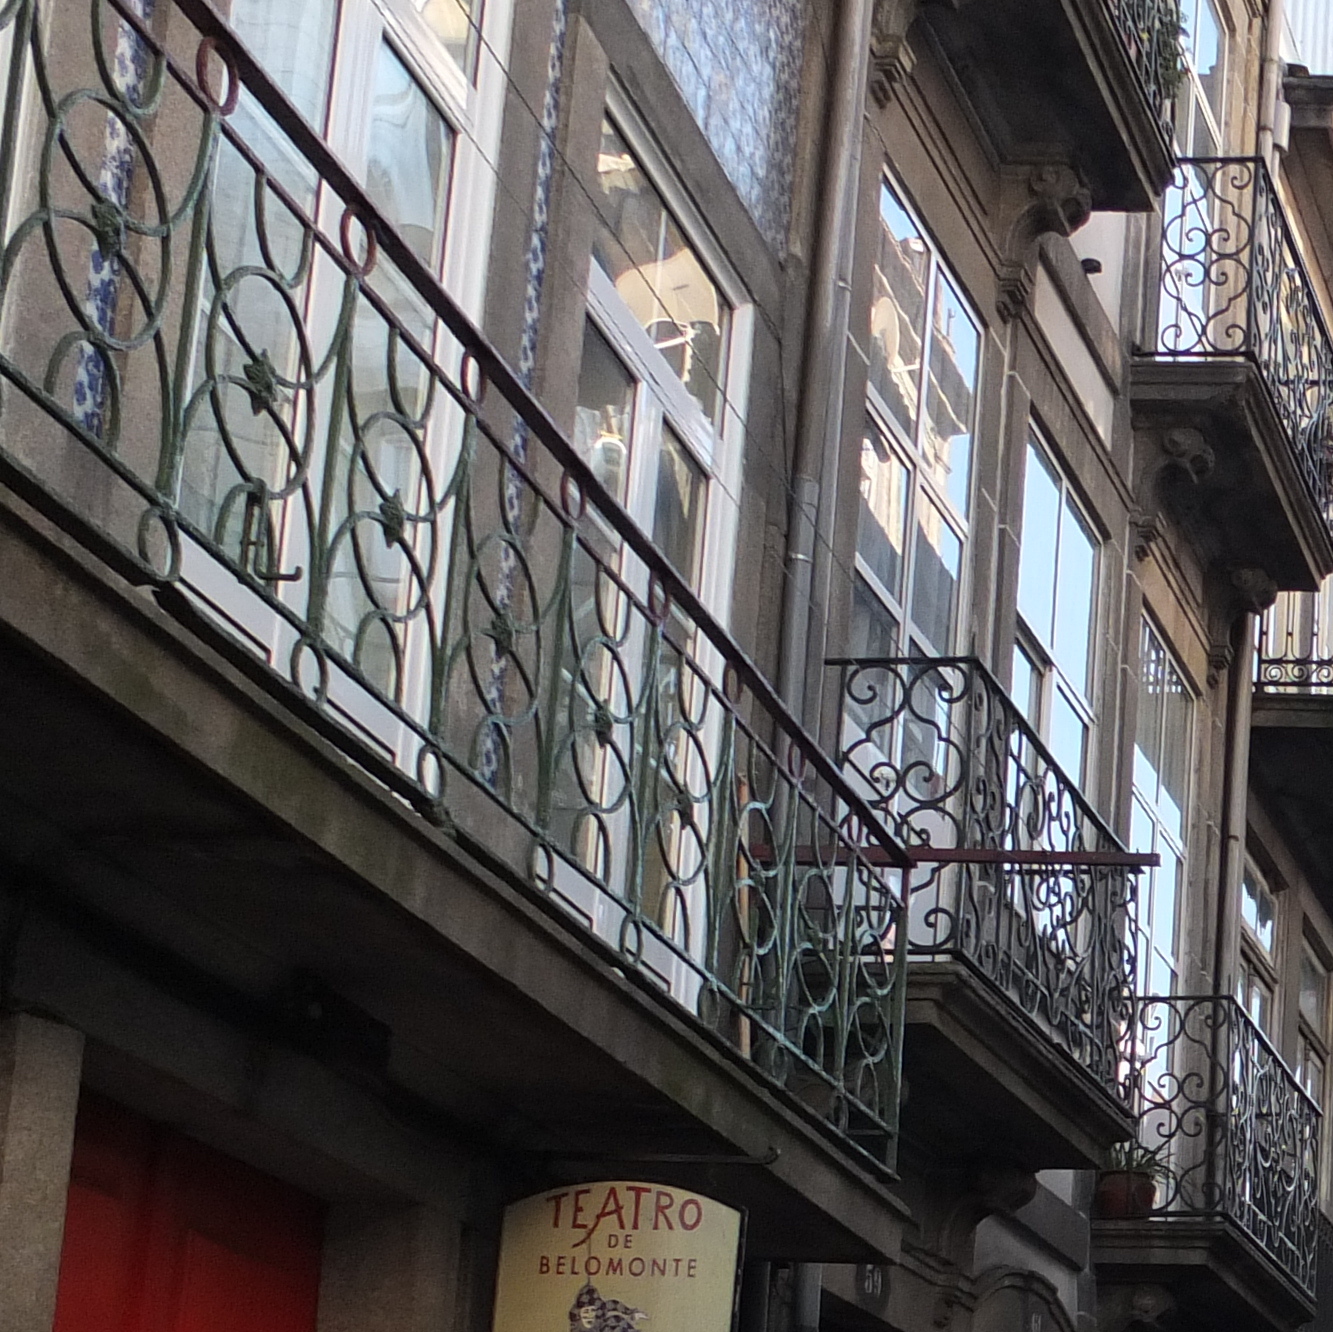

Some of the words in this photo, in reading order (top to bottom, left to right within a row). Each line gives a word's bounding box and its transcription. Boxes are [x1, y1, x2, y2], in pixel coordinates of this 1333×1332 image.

[546, 1186, 703, 1248] TEATRO
[608, 1234, 633, 1249] DE
[538, 1255, 697, 1278] BELOMONTE
